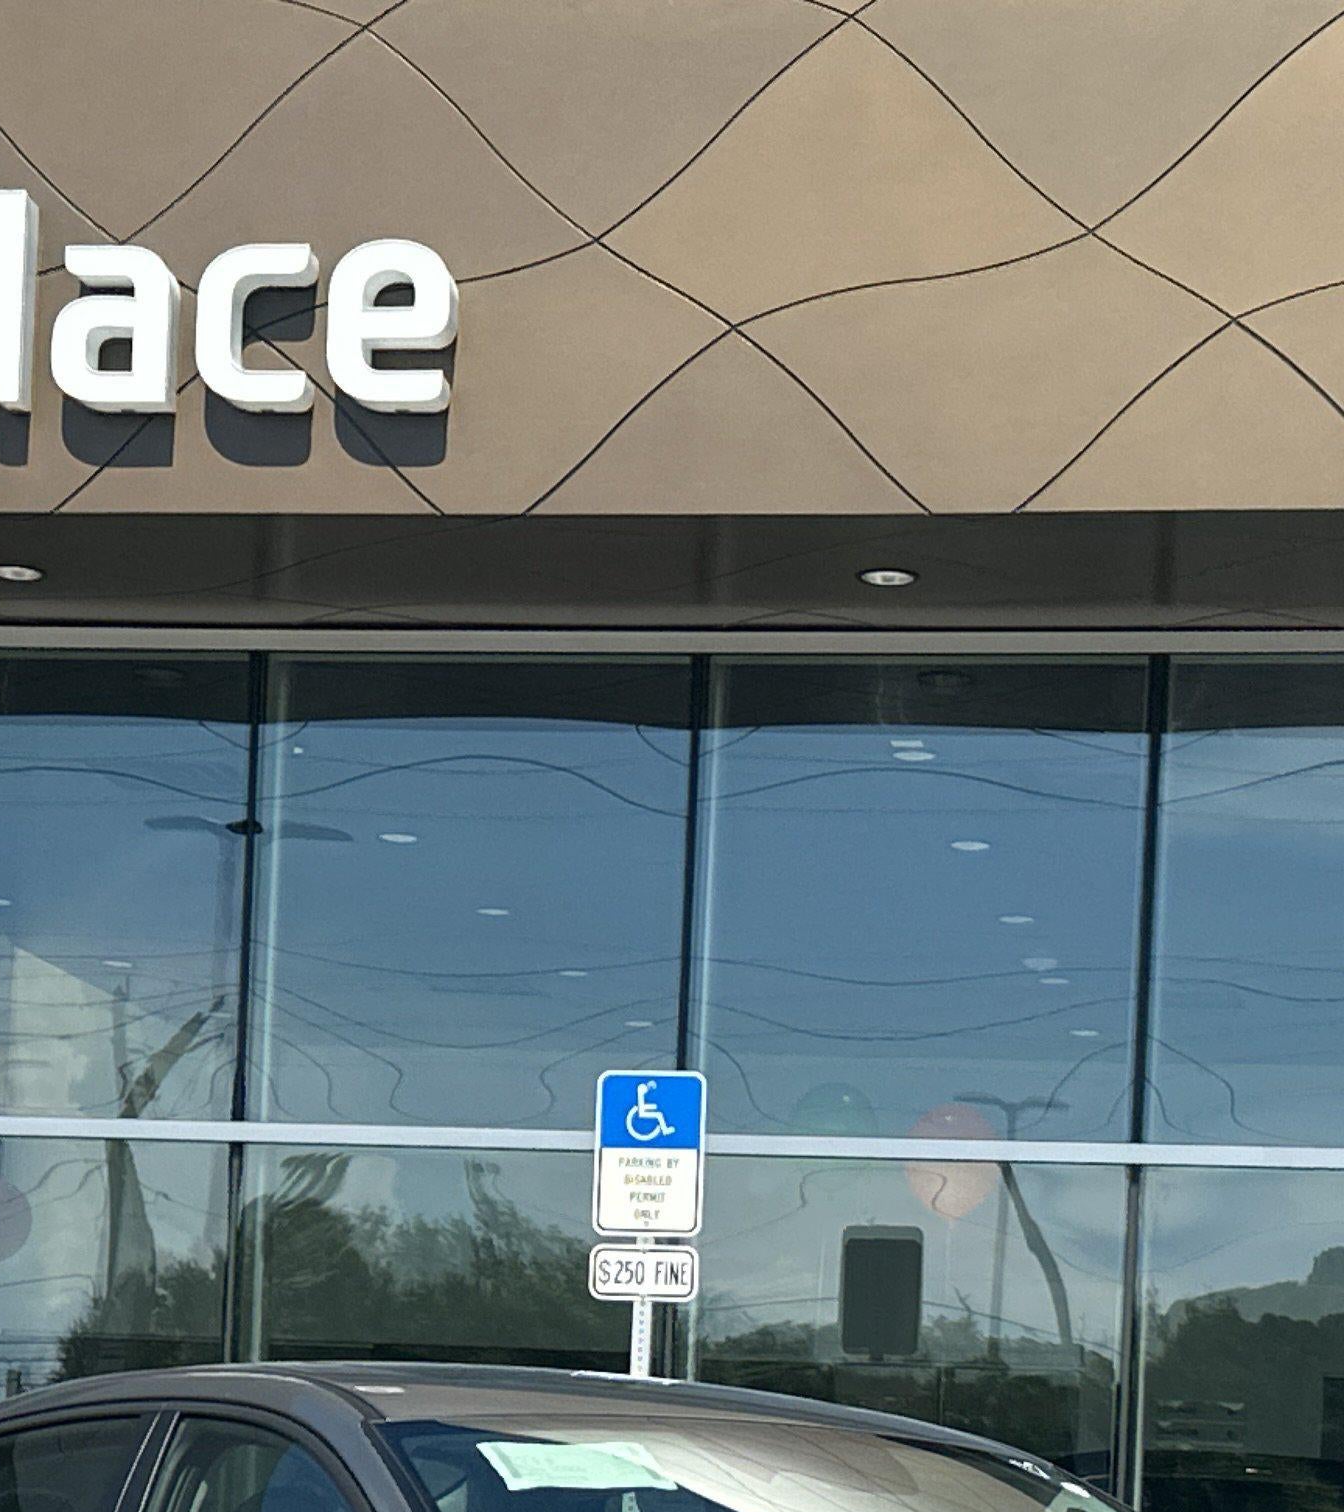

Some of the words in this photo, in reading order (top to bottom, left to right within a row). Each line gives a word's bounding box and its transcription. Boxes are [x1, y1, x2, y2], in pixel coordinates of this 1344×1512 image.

[618, 1157, 662, 1169] PARKING
[666, 1158, 680, 1169] BY
[623, 1174, 673, 1186] DISABLED
[629, 1191, 666, 1203] PERMIT
[598, 1259, 646, 1286] $250
[654, 1261, 689, 1286] FINE
